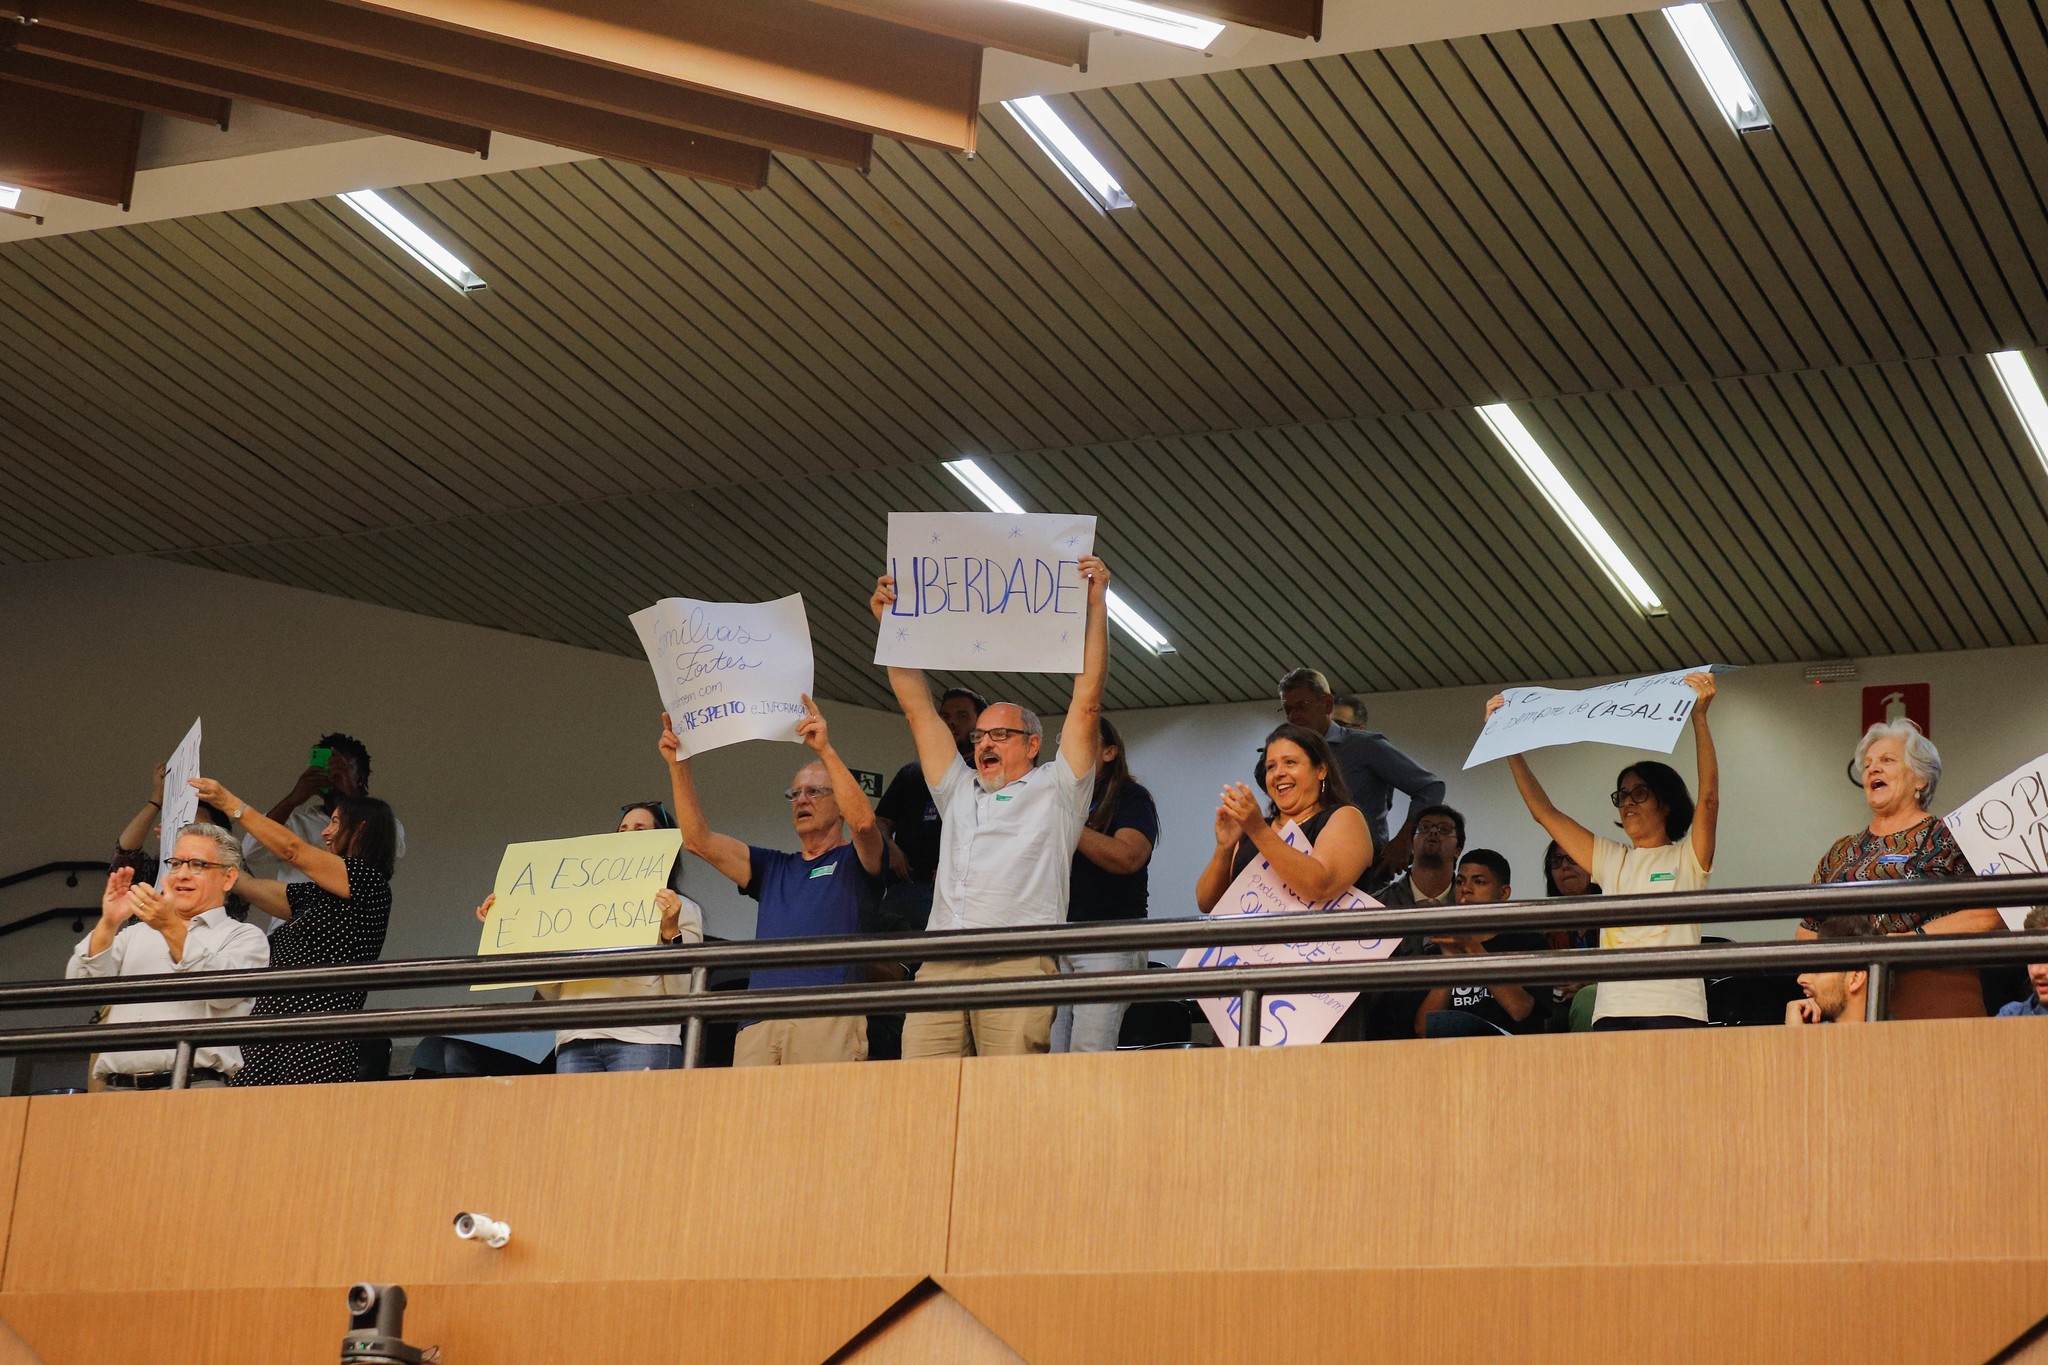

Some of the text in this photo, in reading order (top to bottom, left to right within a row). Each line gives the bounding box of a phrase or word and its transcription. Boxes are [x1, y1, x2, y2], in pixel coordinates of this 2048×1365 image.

[890, 556, 1080, 617] LIBERDADE
[683, 701, 746, 730] RESPEITO
[509, 853, 666, 896] A ESCOLHA
[496, 899, 661, 948] É DO CASAL
